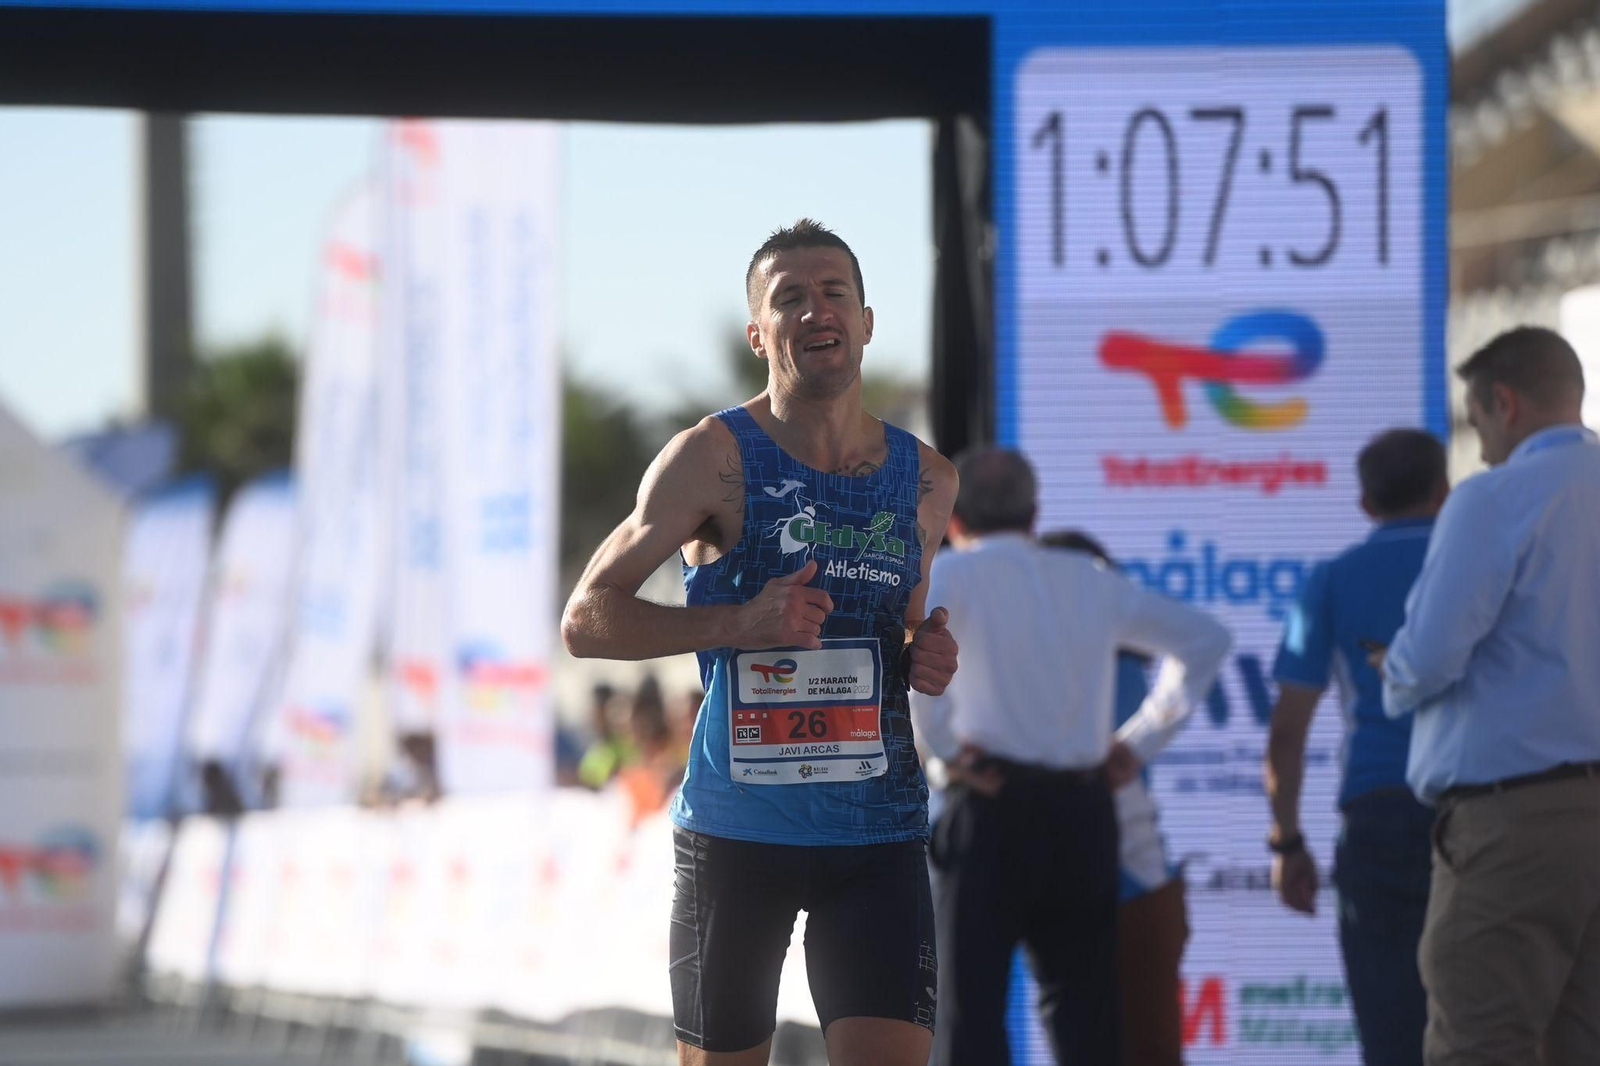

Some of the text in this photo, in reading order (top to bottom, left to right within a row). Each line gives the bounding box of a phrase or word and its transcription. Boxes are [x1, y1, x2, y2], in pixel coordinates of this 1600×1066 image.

[1032, 105, 1389, 267] 1:07:51
[825, 560, 901, 587] Atletismo
[820, 675, 858, 684] MARATÓN
[751, 687, 797, 696] TotalEnergies
[808, 685, 870, 695] DE MÁLAGA 2022
[787, 710, 827, 739] 26
[779, 744, 840, 756] JAVI ARCAS
